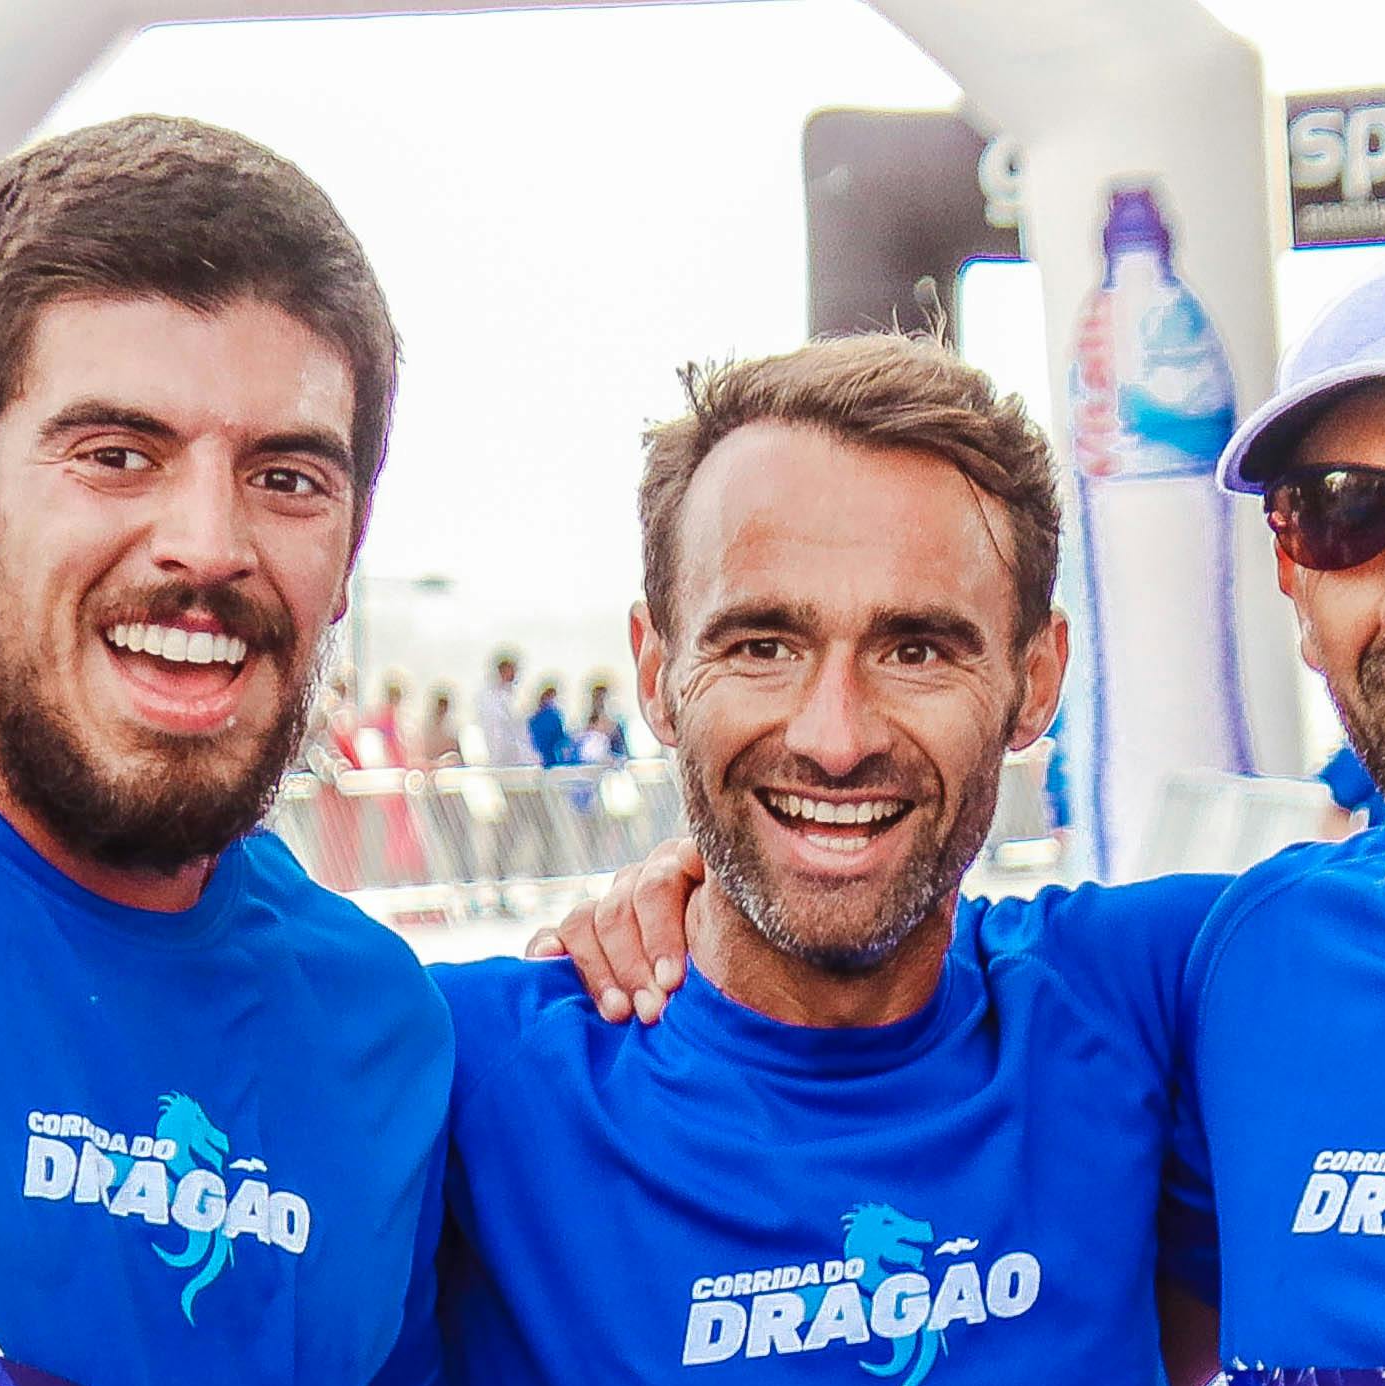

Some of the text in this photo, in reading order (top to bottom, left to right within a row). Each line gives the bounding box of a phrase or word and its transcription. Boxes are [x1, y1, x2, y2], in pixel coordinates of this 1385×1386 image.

[130, 1135, 177, 1160] DO
[24, 1135, 311, 1254] DRAGÃO
[682, 1237, 1041, 1366] DRAGÃO
[692, 1257, 865, 1300] CORRIDA DO
